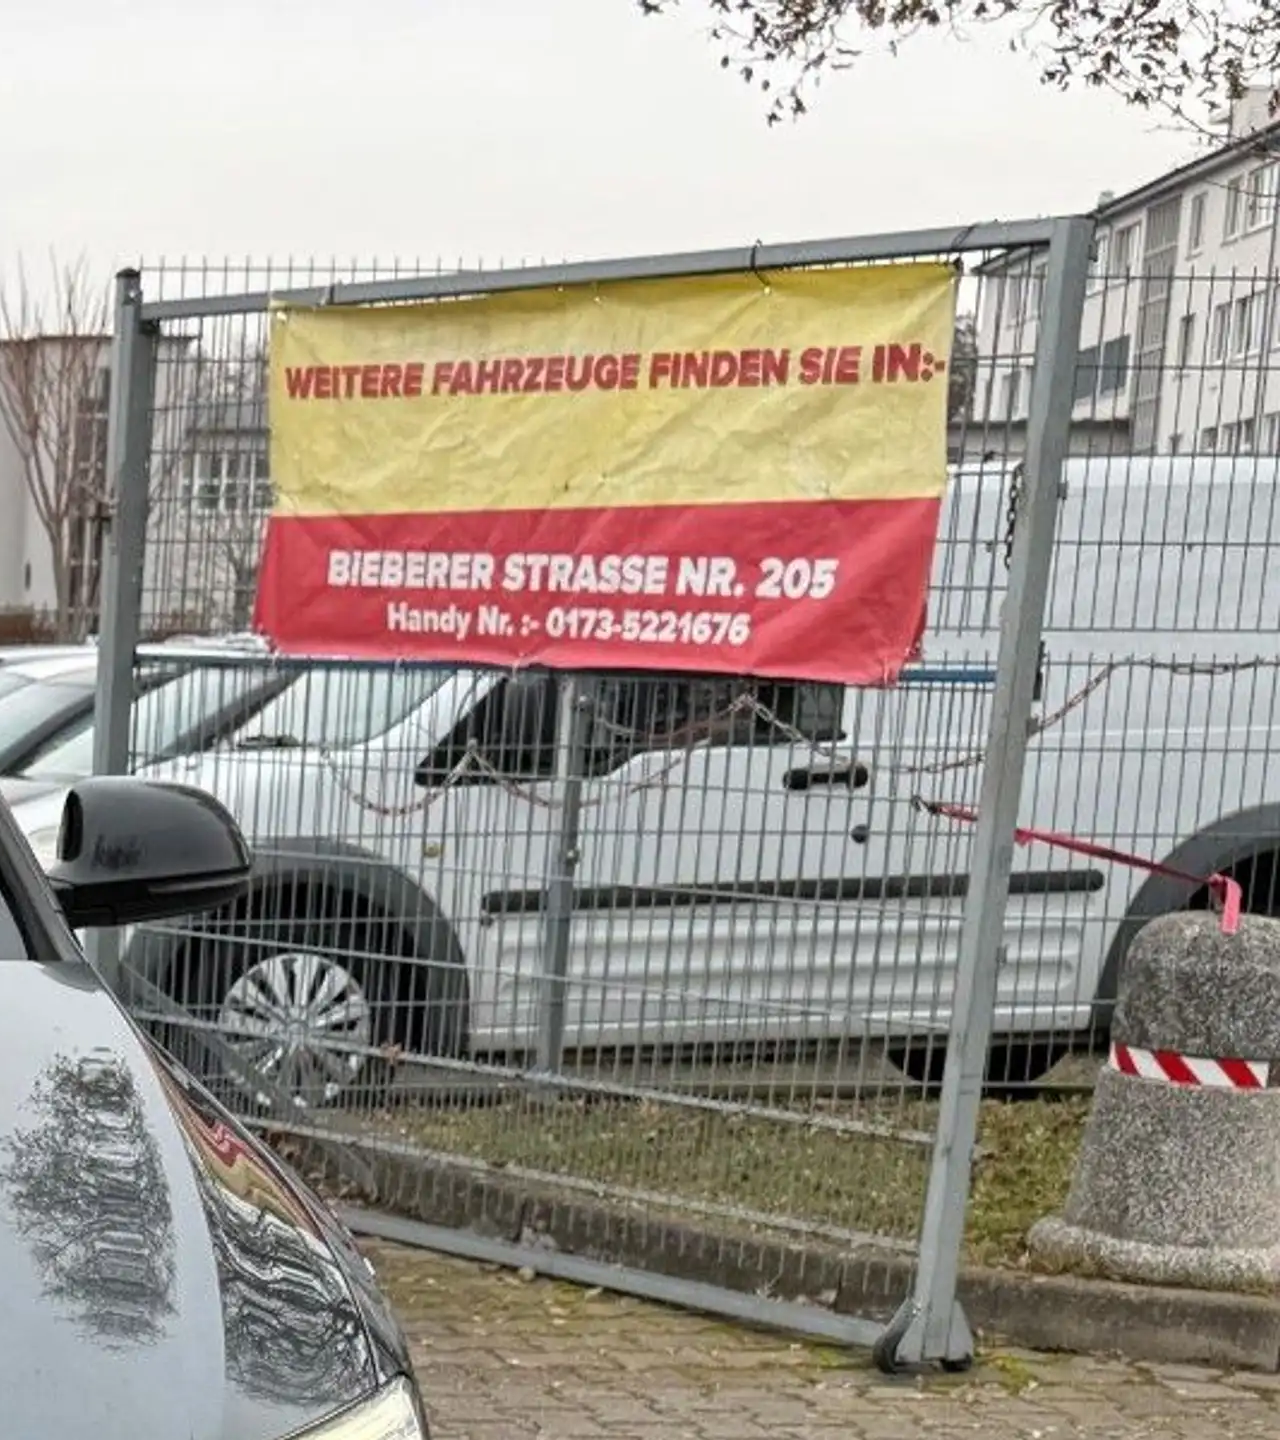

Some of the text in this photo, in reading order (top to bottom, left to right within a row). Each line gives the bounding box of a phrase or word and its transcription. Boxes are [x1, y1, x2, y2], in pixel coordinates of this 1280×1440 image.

[285, 363, 425, 400] WEITERE
[431, 353, 641, 396] FAHRZEUGE
[648, 349, 790, 390] FINDEN
[797, 345, 863, 385] SIE
[327, 550, 839, 599] BIEBERER STRASSE NR. 205
[387, 601, 472, 641] Handy
[477, 605, 514, 637] Nr.
[545, 607, 753, 645] 0173-5221676
